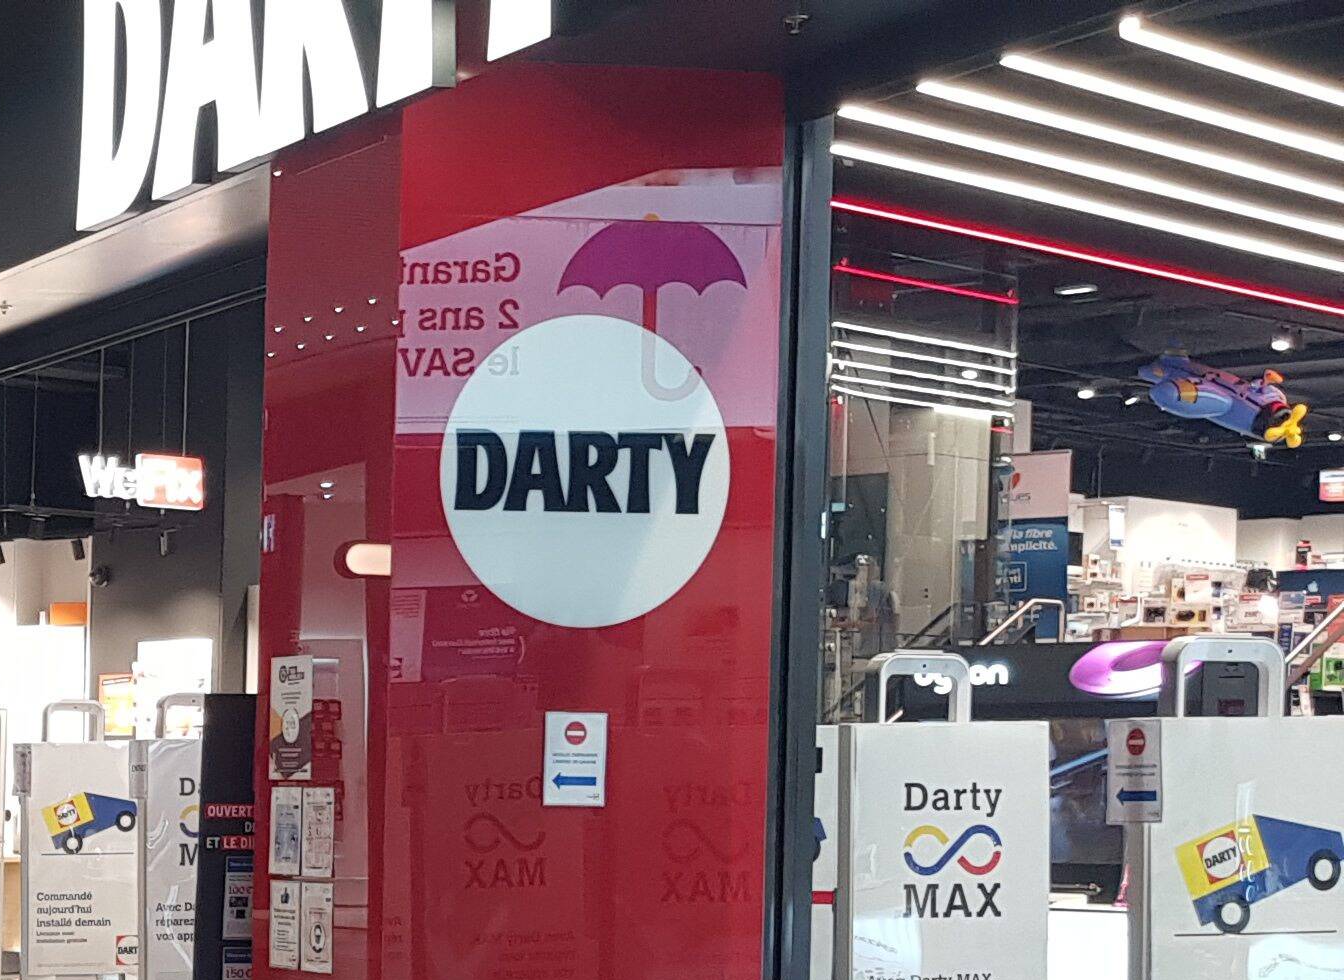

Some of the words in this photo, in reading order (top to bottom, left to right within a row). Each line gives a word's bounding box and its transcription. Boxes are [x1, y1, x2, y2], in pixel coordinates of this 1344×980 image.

[454, 428, 716, 514] DARTY
[904, 782, 1002, 817] Darty
[207, 805, 253, 818] OUVERT
[206, 837, 220, 849] ET
[223, 838, 238, 849] LE
[1204, 846, 1239, 869] DARTY
[37, 892, 92, 901] Commandé
[903, 883, 1002, 918] MAX
[37, 918, 72, 927] installé
[75, 917, 111, 927] demain
[117, 947, 138, 955] DART
